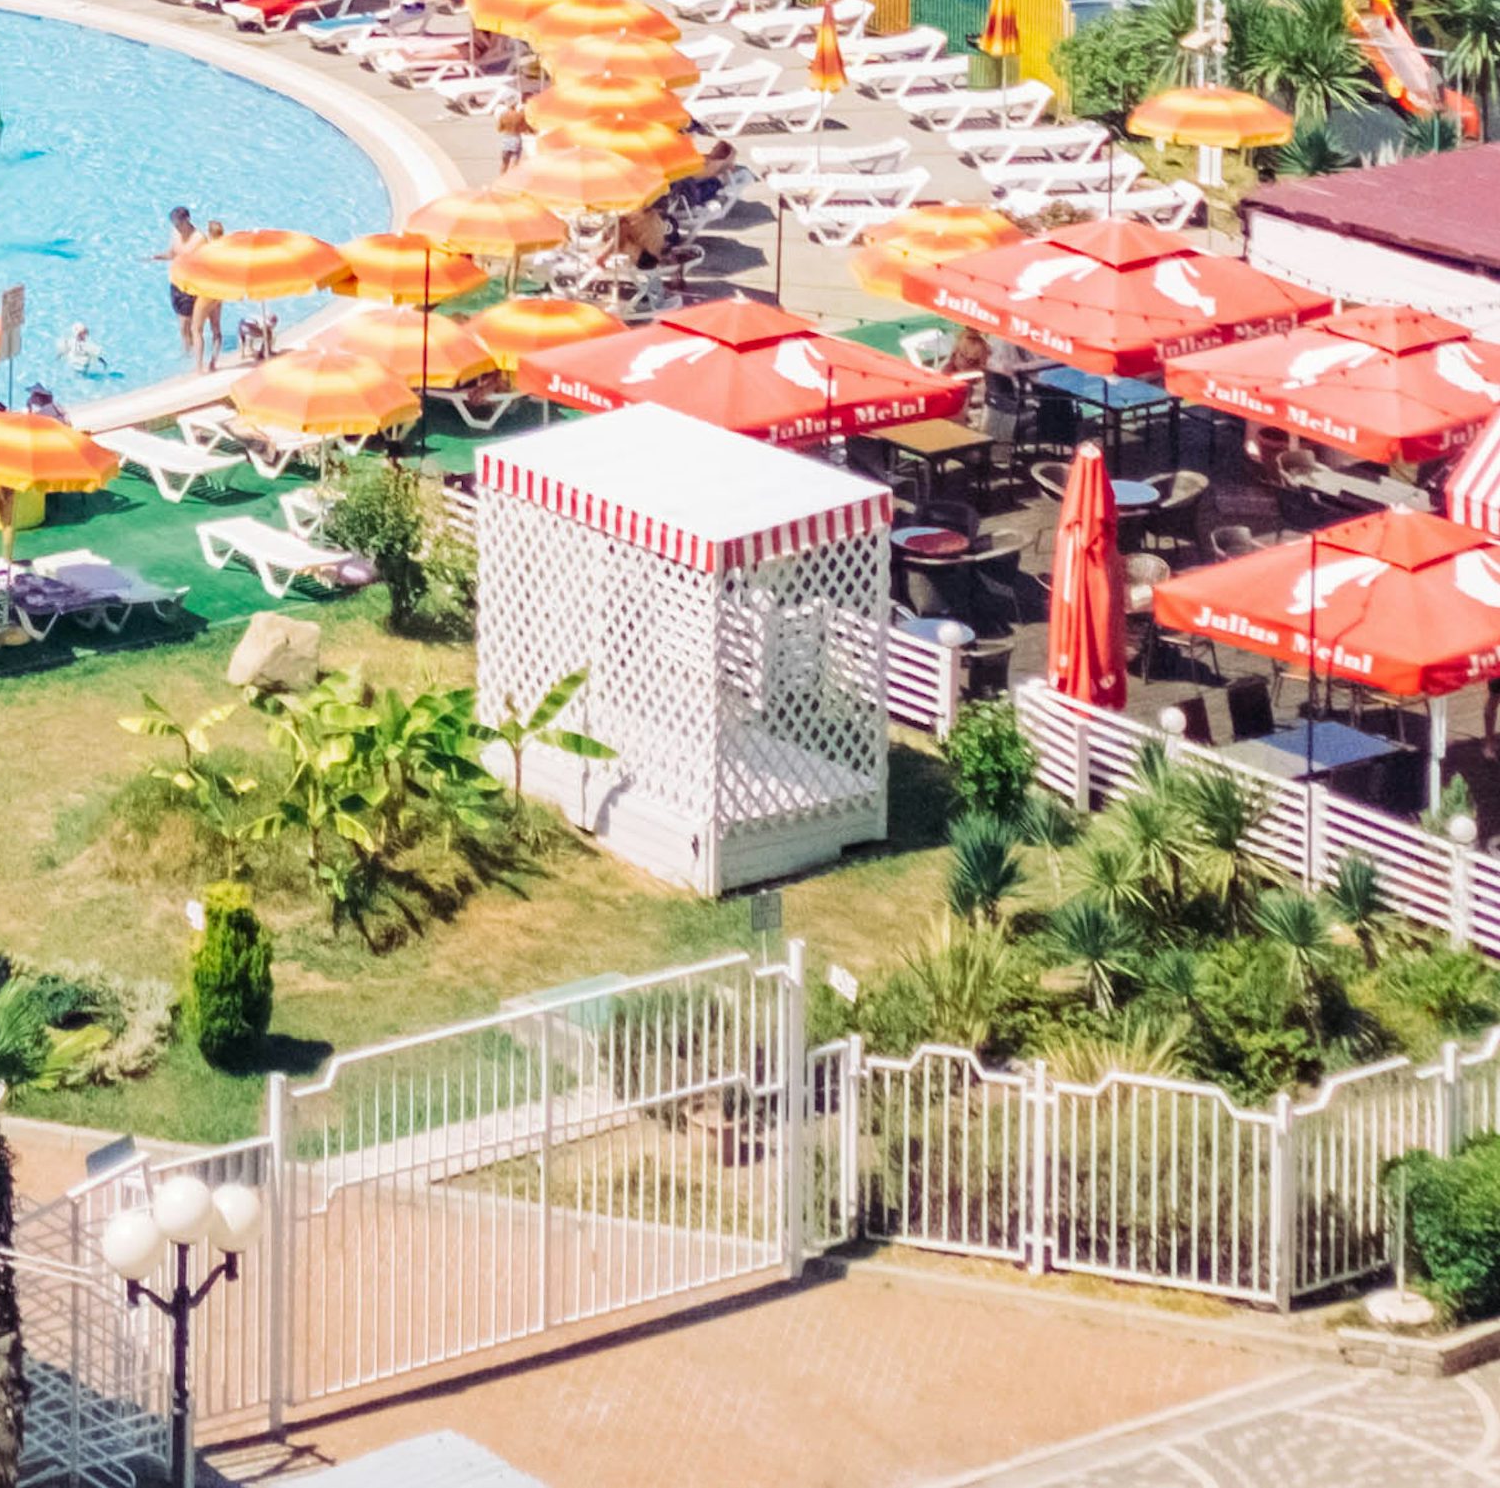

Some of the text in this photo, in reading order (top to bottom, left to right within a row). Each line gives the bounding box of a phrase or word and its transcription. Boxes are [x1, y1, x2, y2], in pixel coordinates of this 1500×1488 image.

[933, 288, 1074, 355] Julius Meinl
[547, 373, 614, 410] Julius
[768, 396, 926, 444] Julius Meinl
[1202, 379, 1358, 444] Julius Meinl
[1192, 606, 1374, 674] Julius Meinl
